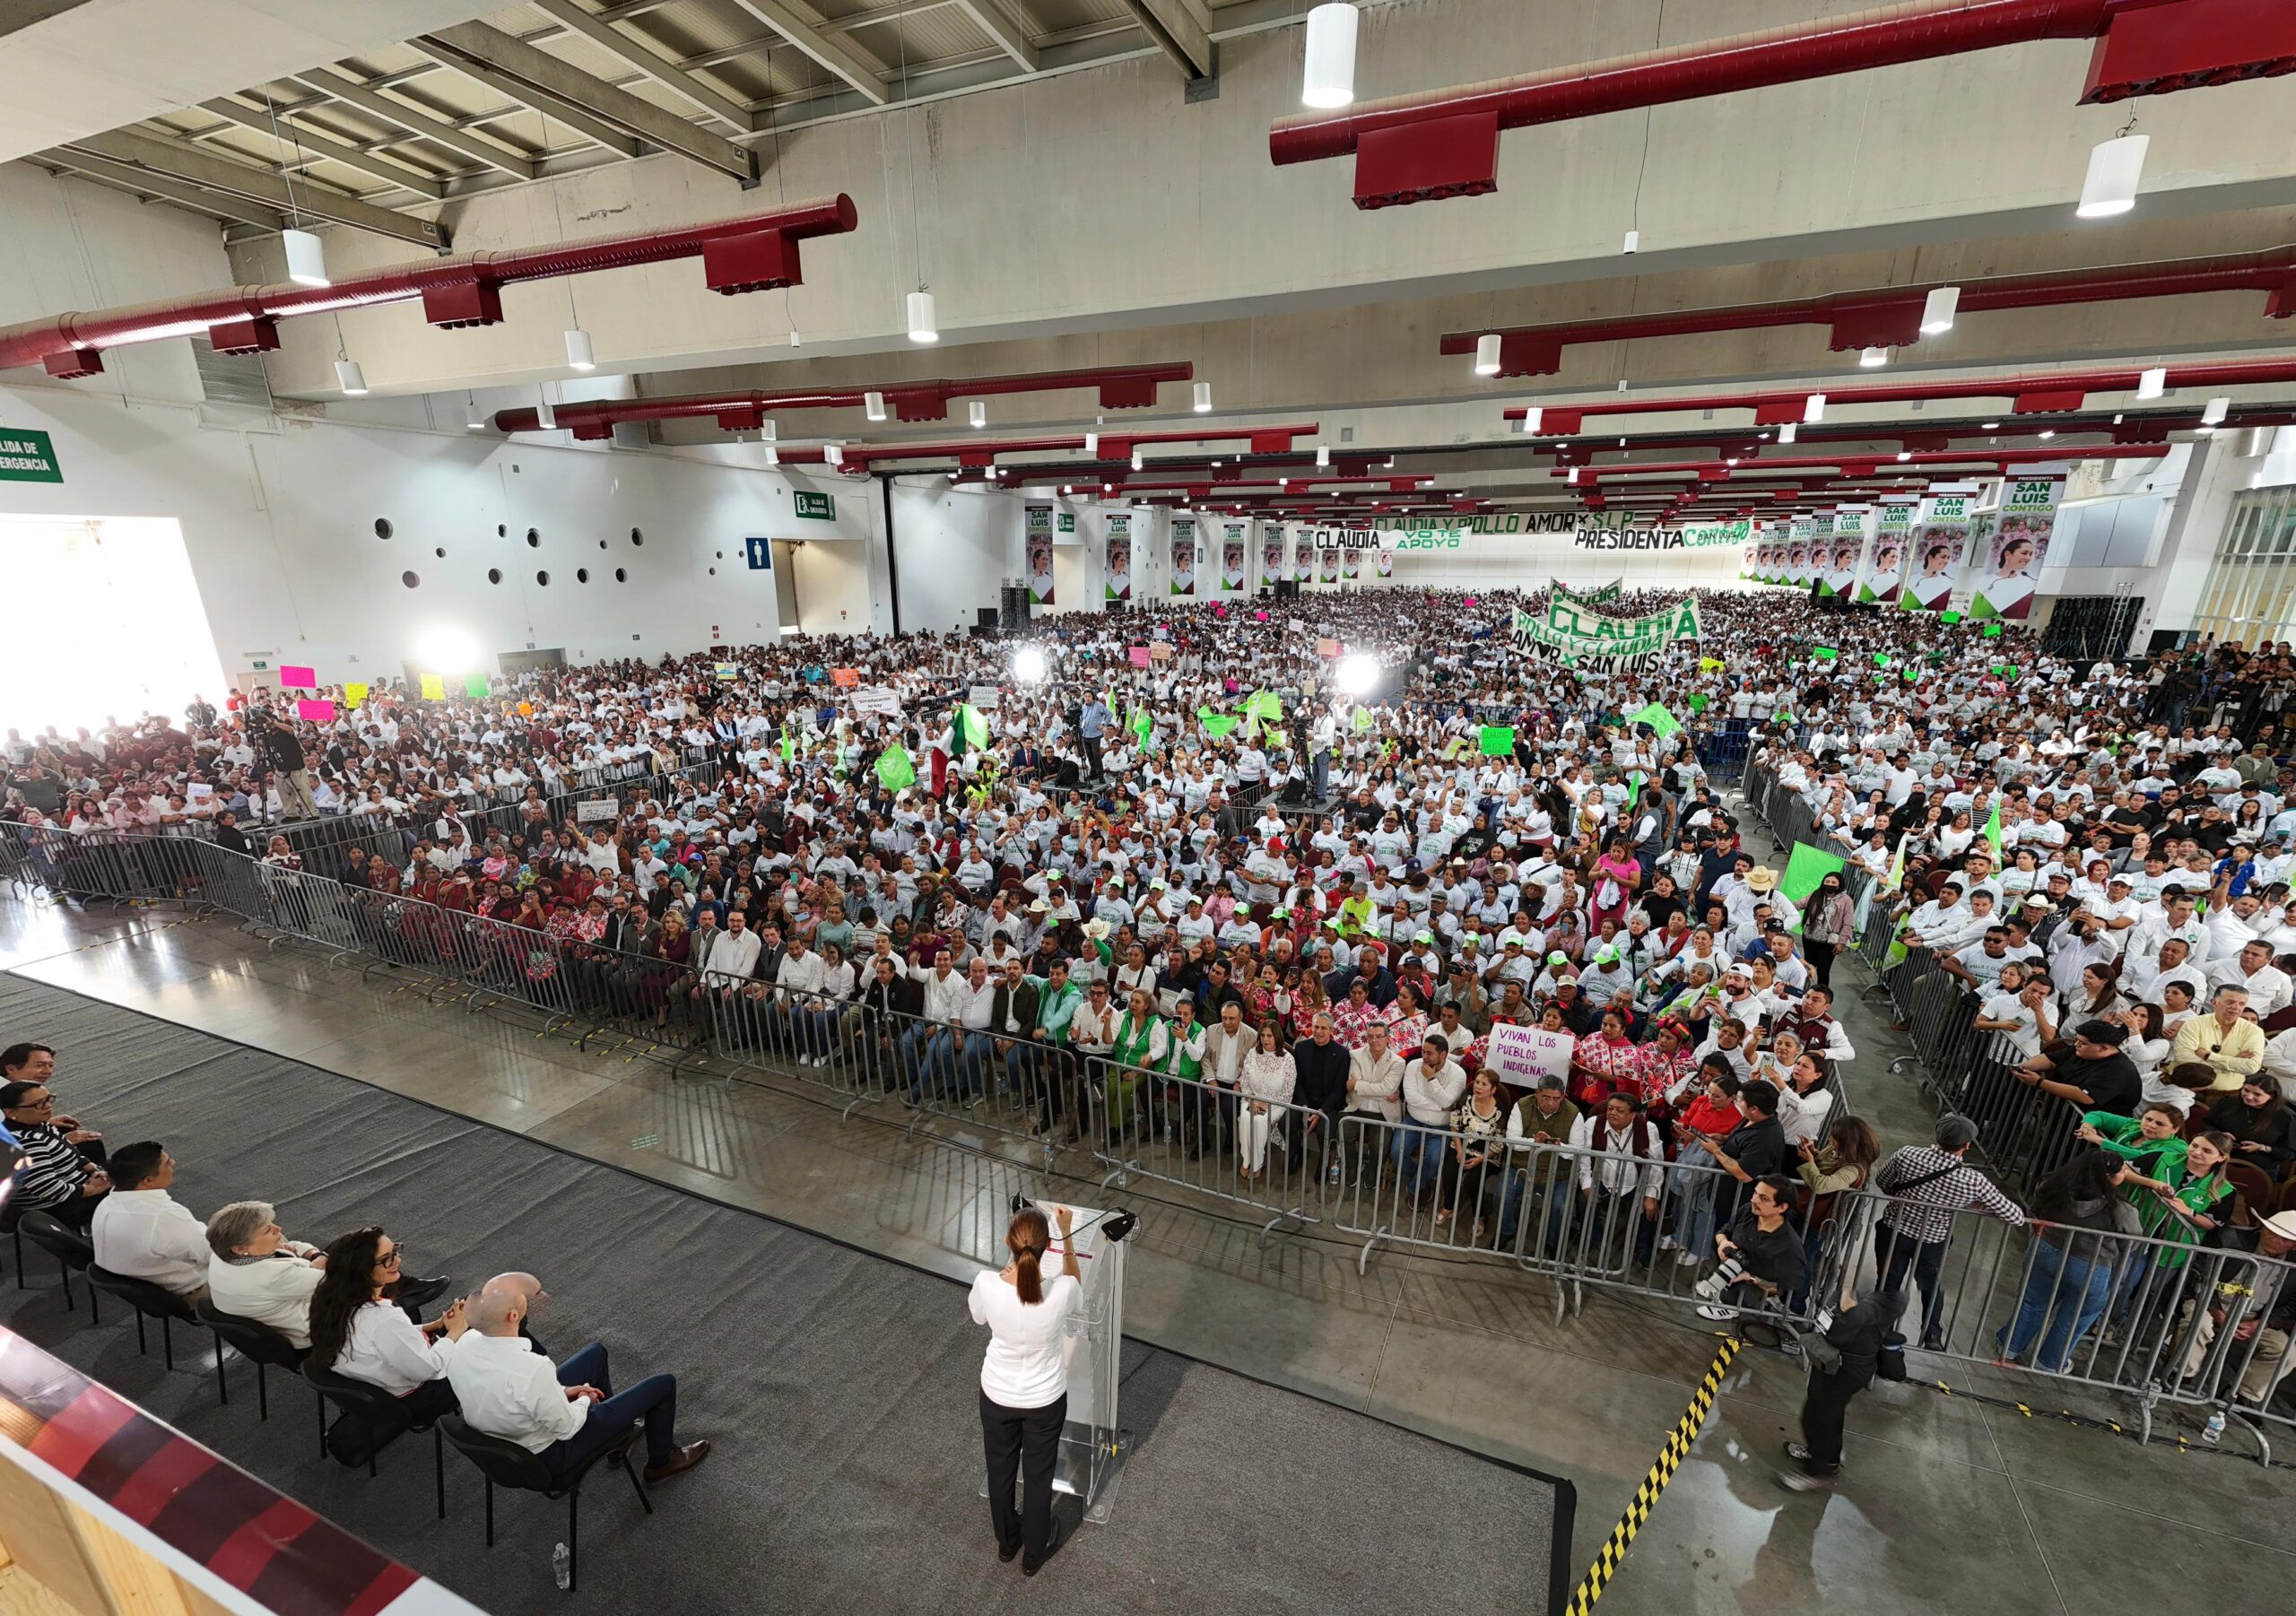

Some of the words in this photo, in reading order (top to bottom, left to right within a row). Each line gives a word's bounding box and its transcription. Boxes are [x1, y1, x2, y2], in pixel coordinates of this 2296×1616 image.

[22, 441, 39, 455] DE
[0, 456, 51, 471] ERGENCIA
[2016, 482, 2051, 492] SAN
[1936, 499, 1964, 507] SAN
[2012, 493, 2049, 503] LUIS
[2002, 504, 2054, 512] CONTIGO
[1442, 518, 1454, 530] Y
[1526, 513, 1576, 533] AMOR
[1840, 521, 1861, 530] LUIS
[1316, 530, 1380, 549] CLAUDIA
[1437, 529, 1461, 538] TE
[1575, 528, 1685, 550] PRESIDENTA
[1396, 538, 1460, 549] APOYO
[1549, 604, 1698, 639] CLAUDIA
[1517, 611, 1564, 646] POLLO
[1570, 639, 1585, 651] Y
[1583, 632, 1663, 656] CLAUDIA
[1577, 654, 1615, 674] SAN
[1620, 651, 1659, 674] LUIS
[1500, 1029, 1531, 1044] VIVAN
[1538, 1036, 1556, 1048] LOS
[1497, 1044, 1536, 1060] PUEBLOS
[1502, 1060, 1547, 1077] INDIGENAS
